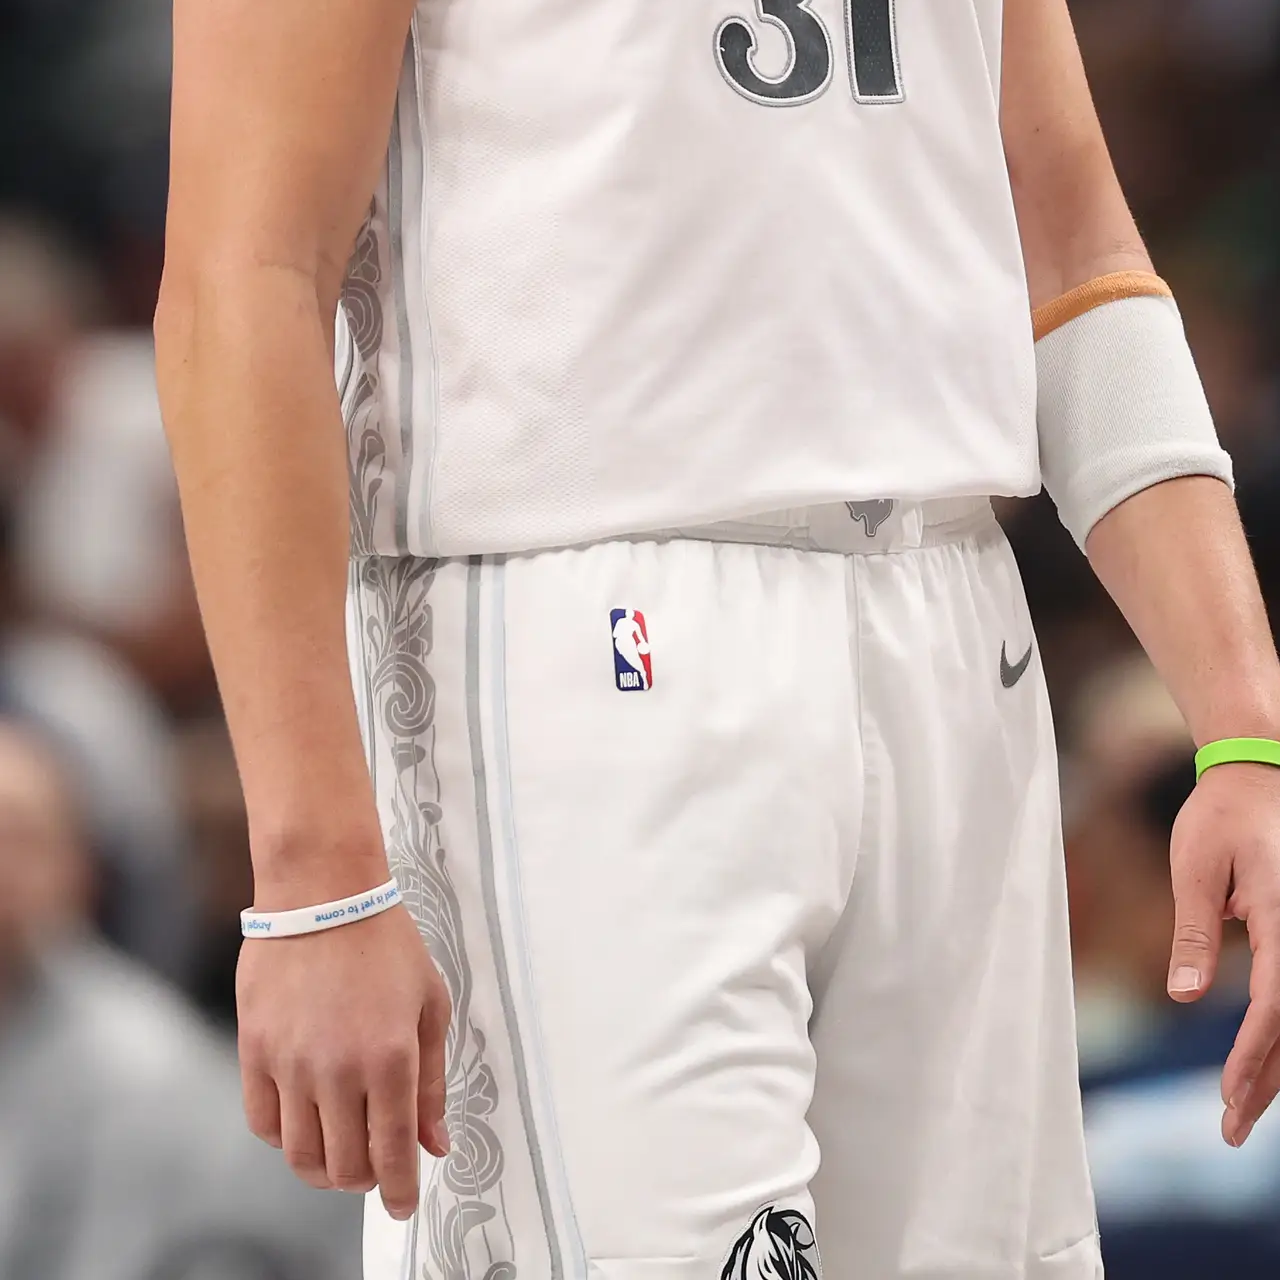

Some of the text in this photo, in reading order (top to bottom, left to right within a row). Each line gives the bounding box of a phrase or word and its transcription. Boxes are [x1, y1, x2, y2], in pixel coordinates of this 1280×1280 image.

[620, 671, 640, 688] NBA
[360, 895, 375, 912] yet
[376, 895, 384, 904] is
[315, 908, 345, 923] come
[347, 905, 359, 914] to
[247, 920, 272, 932] Angel
